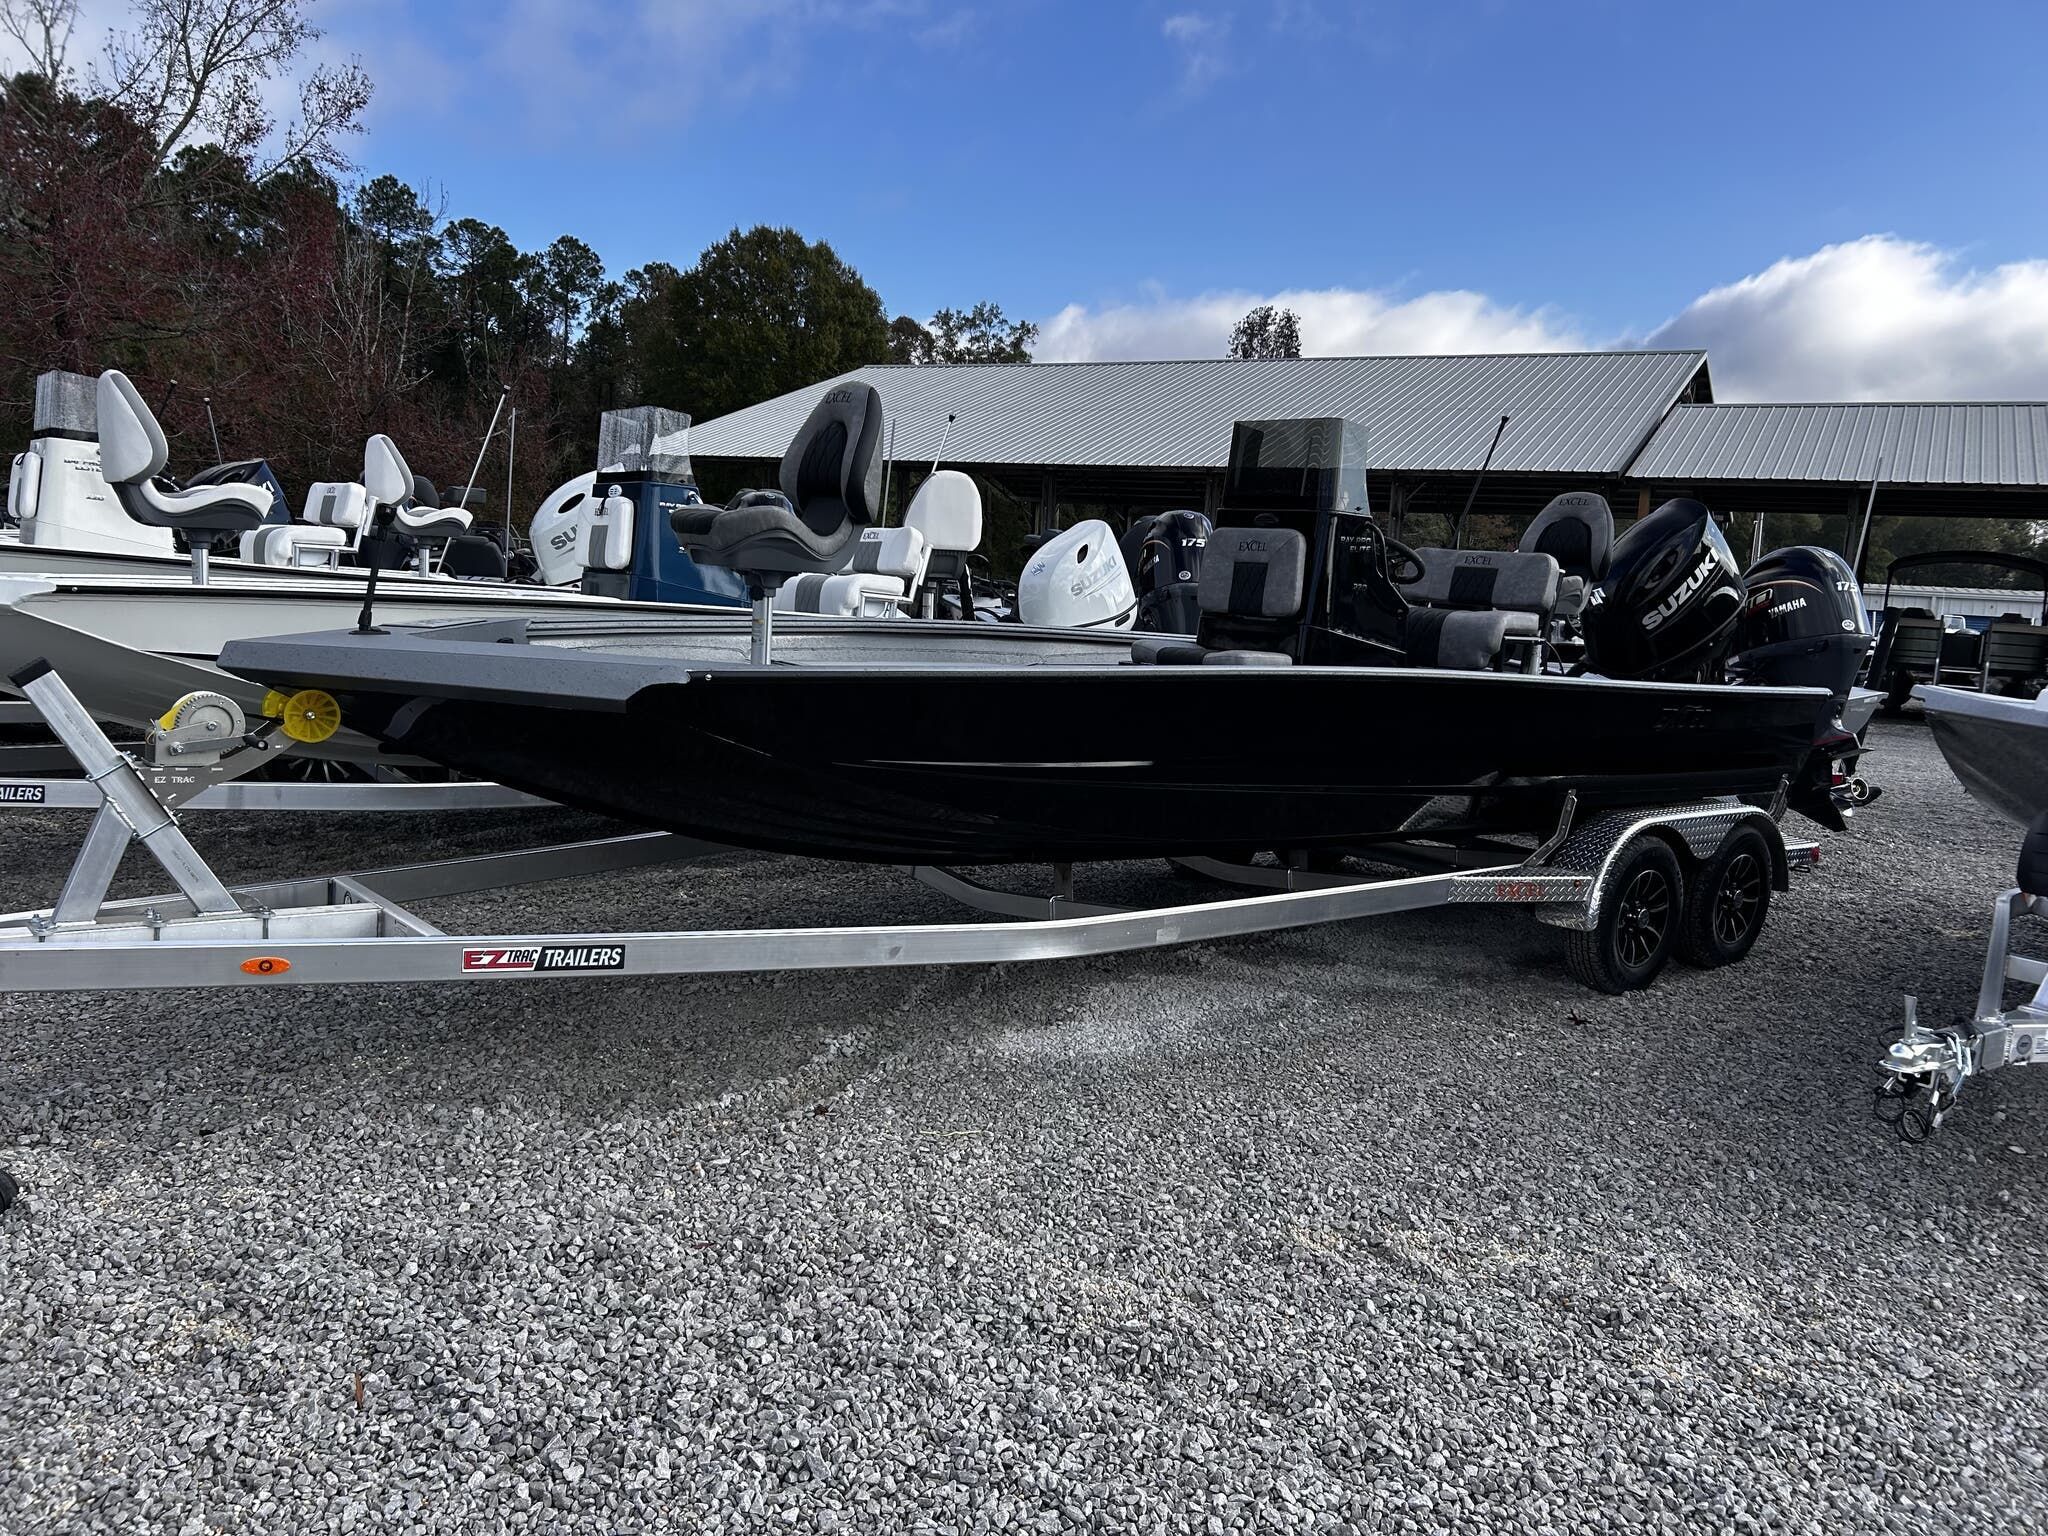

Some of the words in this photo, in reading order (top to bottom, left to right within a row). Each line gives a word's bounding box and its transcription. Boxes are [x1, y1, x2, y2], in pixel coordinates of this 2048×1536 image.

[1558, 497, 1590, 506] EXCEL
[1181, 538, 1206, 548] 175
[1239, 538, 1268, 552] EXCEL
[1464, 555, 1493, 566] EXCEL
[1071, 555, 1117, 597] SUZUKI
[1642, 547, 1720, 630] SUZUKI
[1836, 581, 1858, 592] 175
[1768, 597, 1807, 619] YAMAHA
[154, 776, 167, 784] EZ
[171, 776, 195, 784] TRAC
[544, 948, 623, 967] TRAILERS
